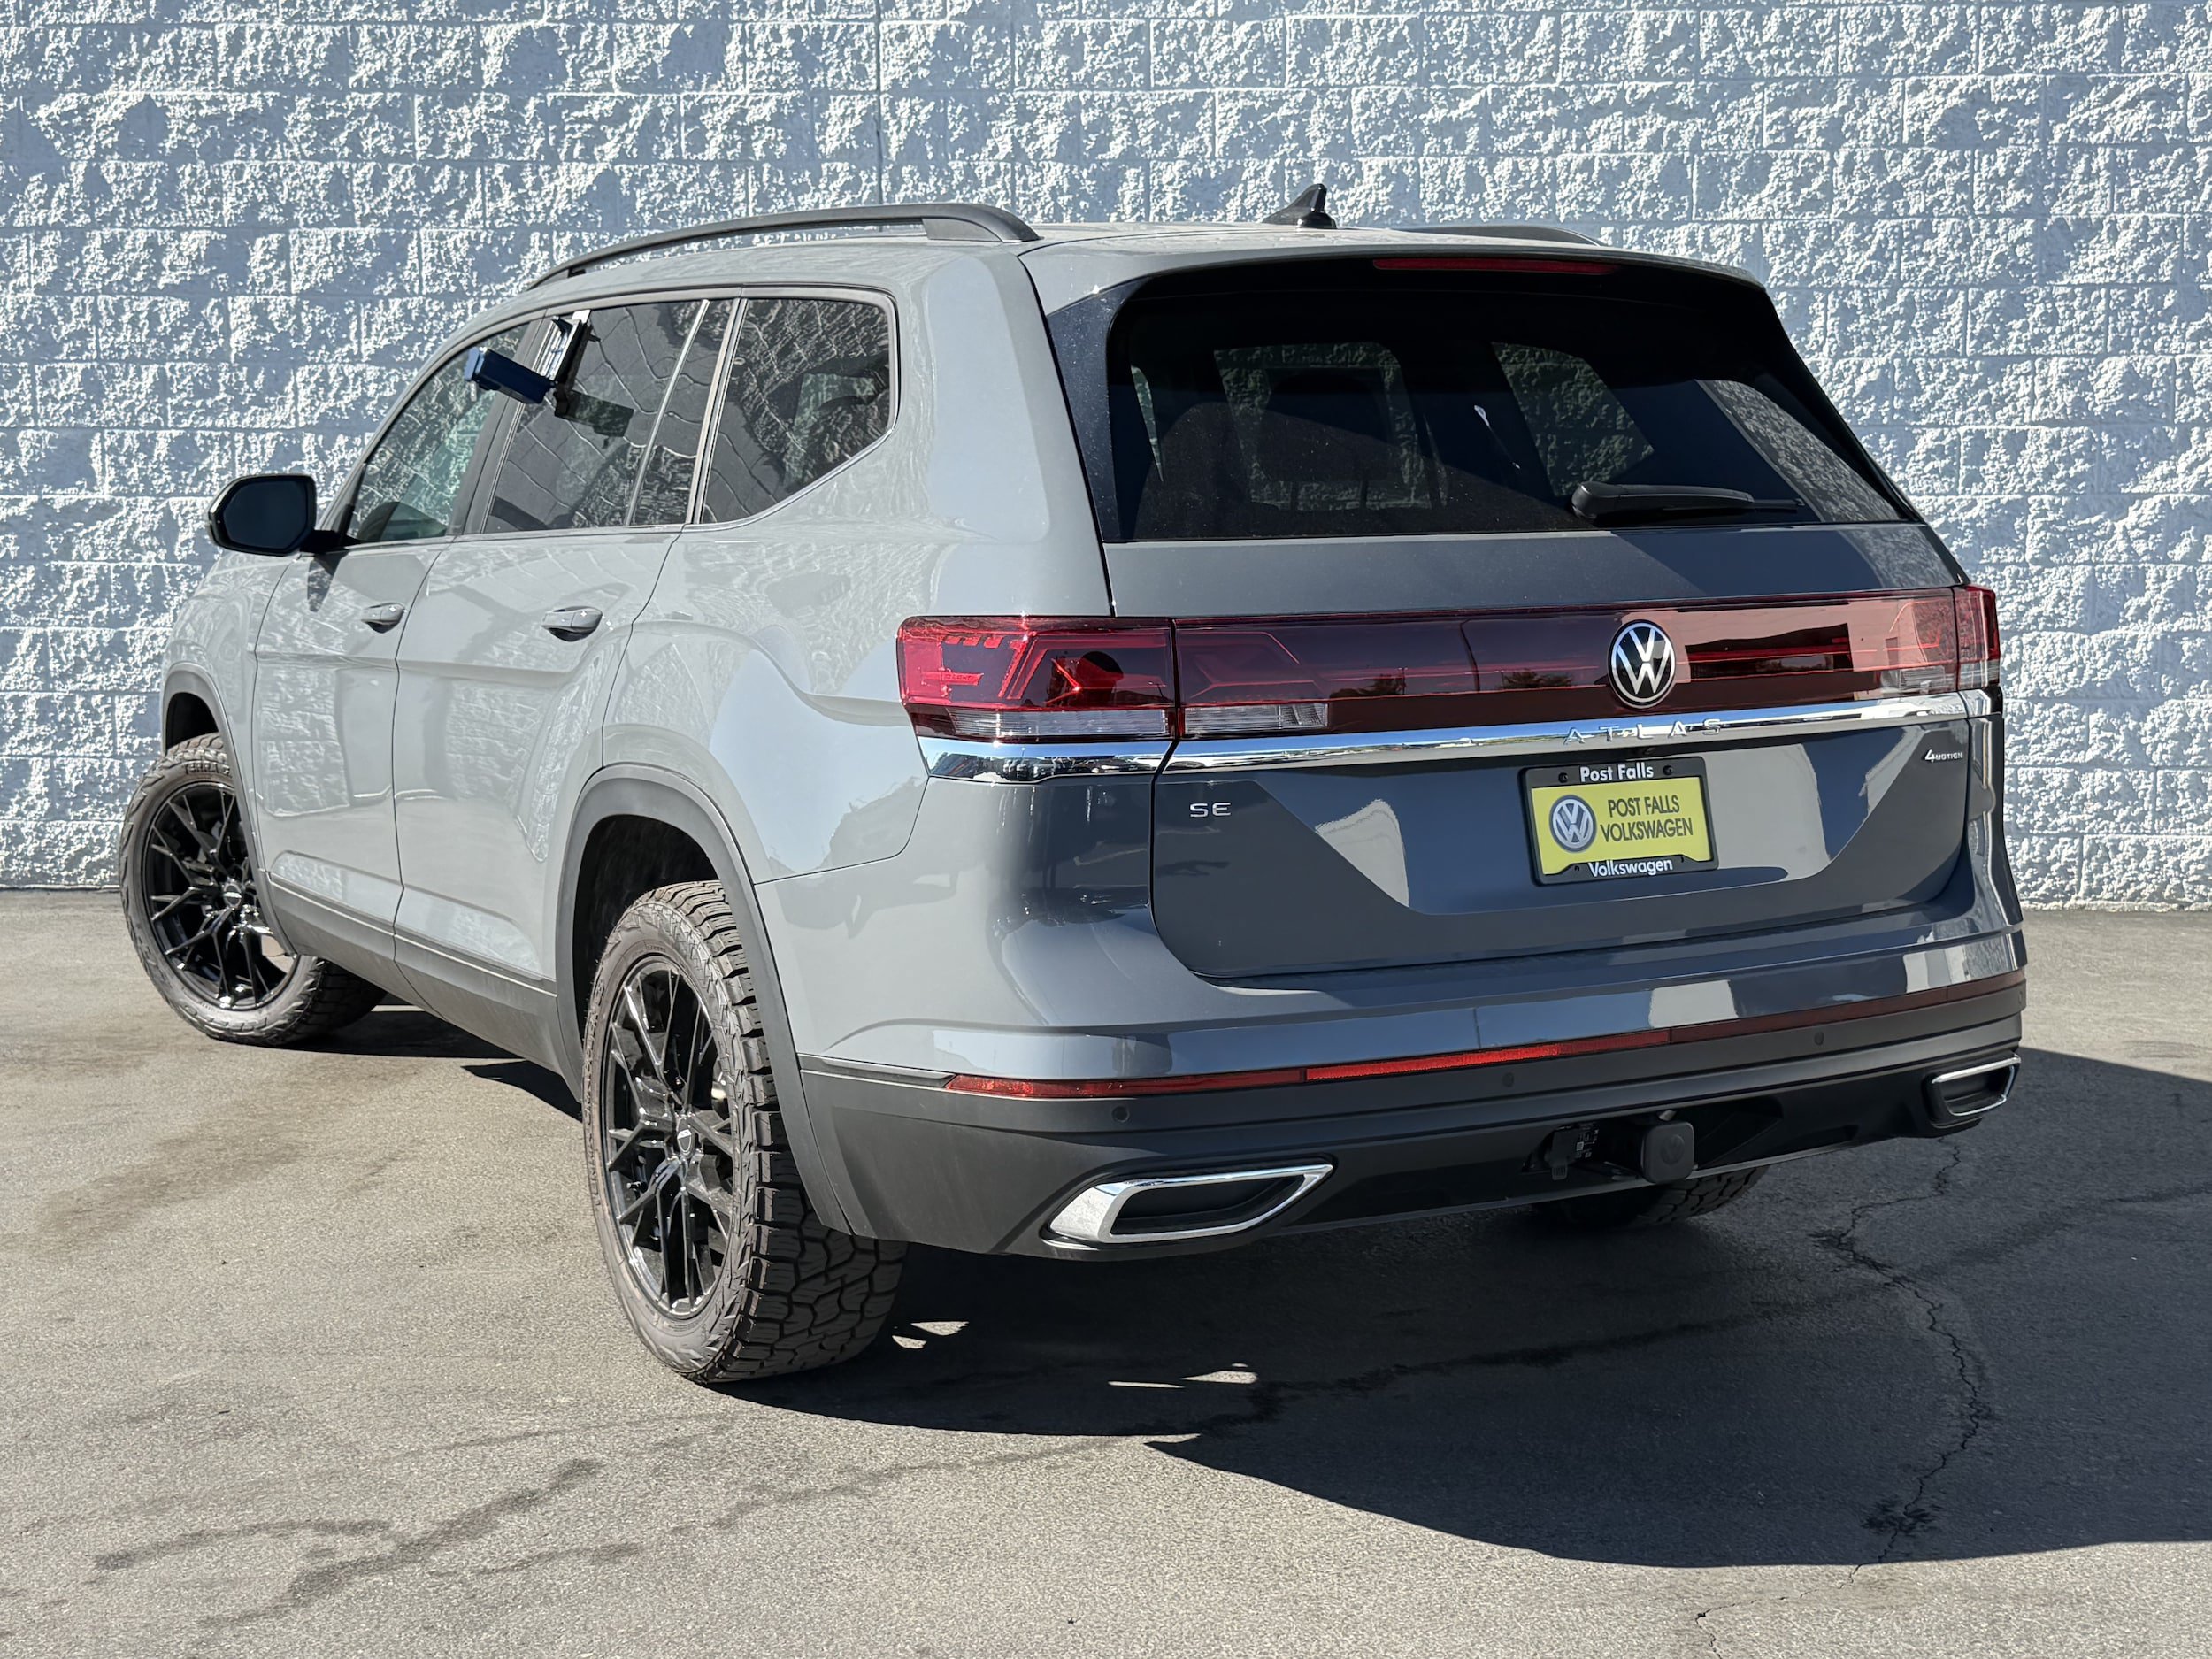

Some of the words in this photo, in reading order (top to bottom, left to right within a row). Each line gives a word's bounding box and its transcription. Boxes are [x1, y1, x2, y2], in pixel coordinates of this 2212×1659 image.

[1563, 718, 1721, 745] ATLAS
[1924, 749, 1962, 763] 4MOTION
[1579, 765, 1613, 783] Post
[1617, 762, 1655, 780] Falls
[1190, 802, 1232, 818] SE
[1608, 796, 1641, 818] POST
[1645, 795, 1680, 815] FALLS
[1600, 818, 1694, 842] VOLKSWAGEN
[1588, 858, 1673, 877] Volkswagen
